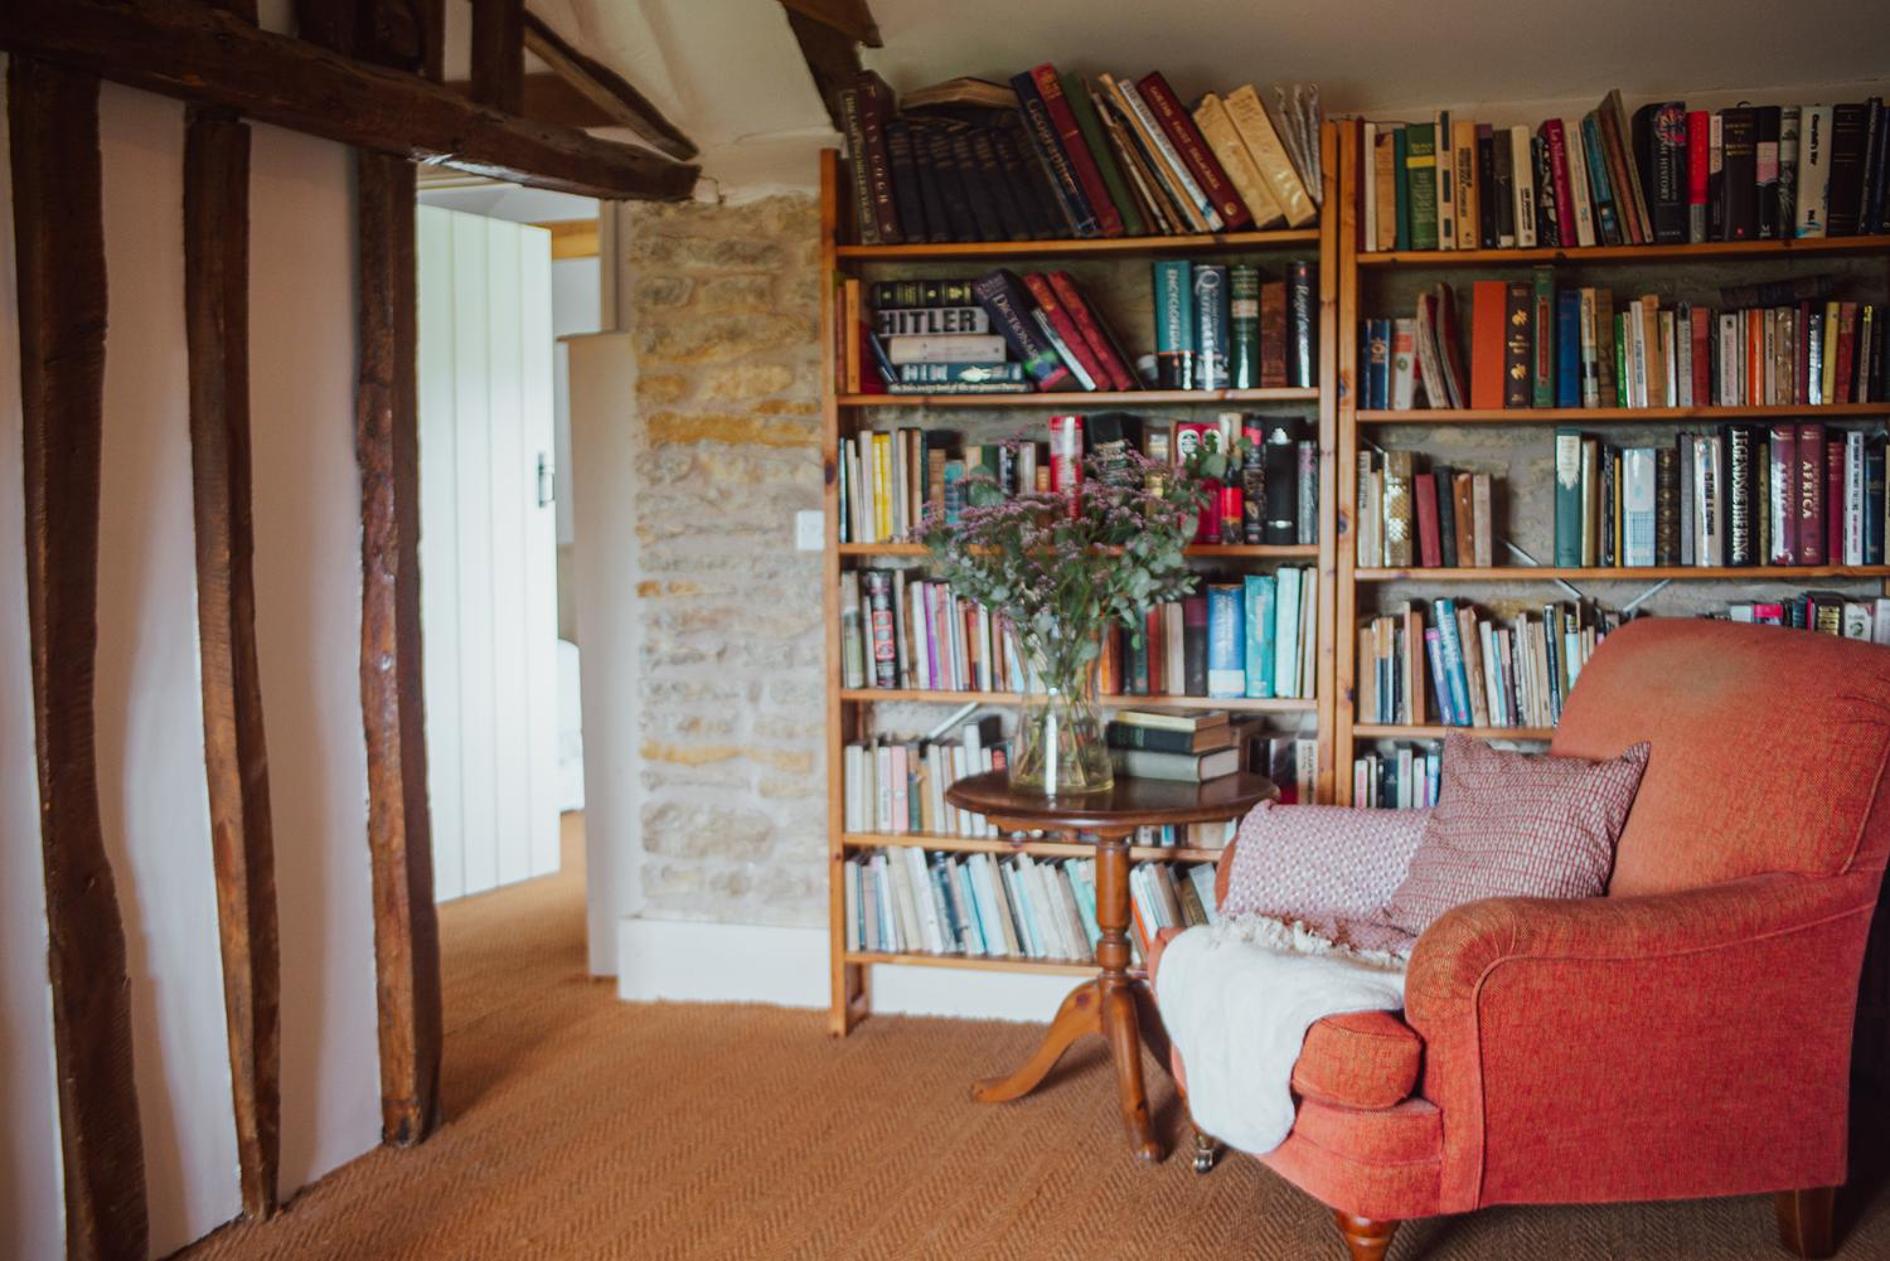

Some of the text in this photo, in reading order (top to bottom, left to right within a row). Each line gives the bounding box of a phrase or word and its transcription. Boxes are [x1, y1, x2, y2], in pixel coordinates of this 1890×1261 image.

[1659, 157, 1670, 200] HISTORY
[879, 308, 977, 335] HITLER
[1732, 429, 1749, 487] LEGENDS
[1802, 461, 1813, 519] AFRICA
[1732, 527, 1749, 561] RING
